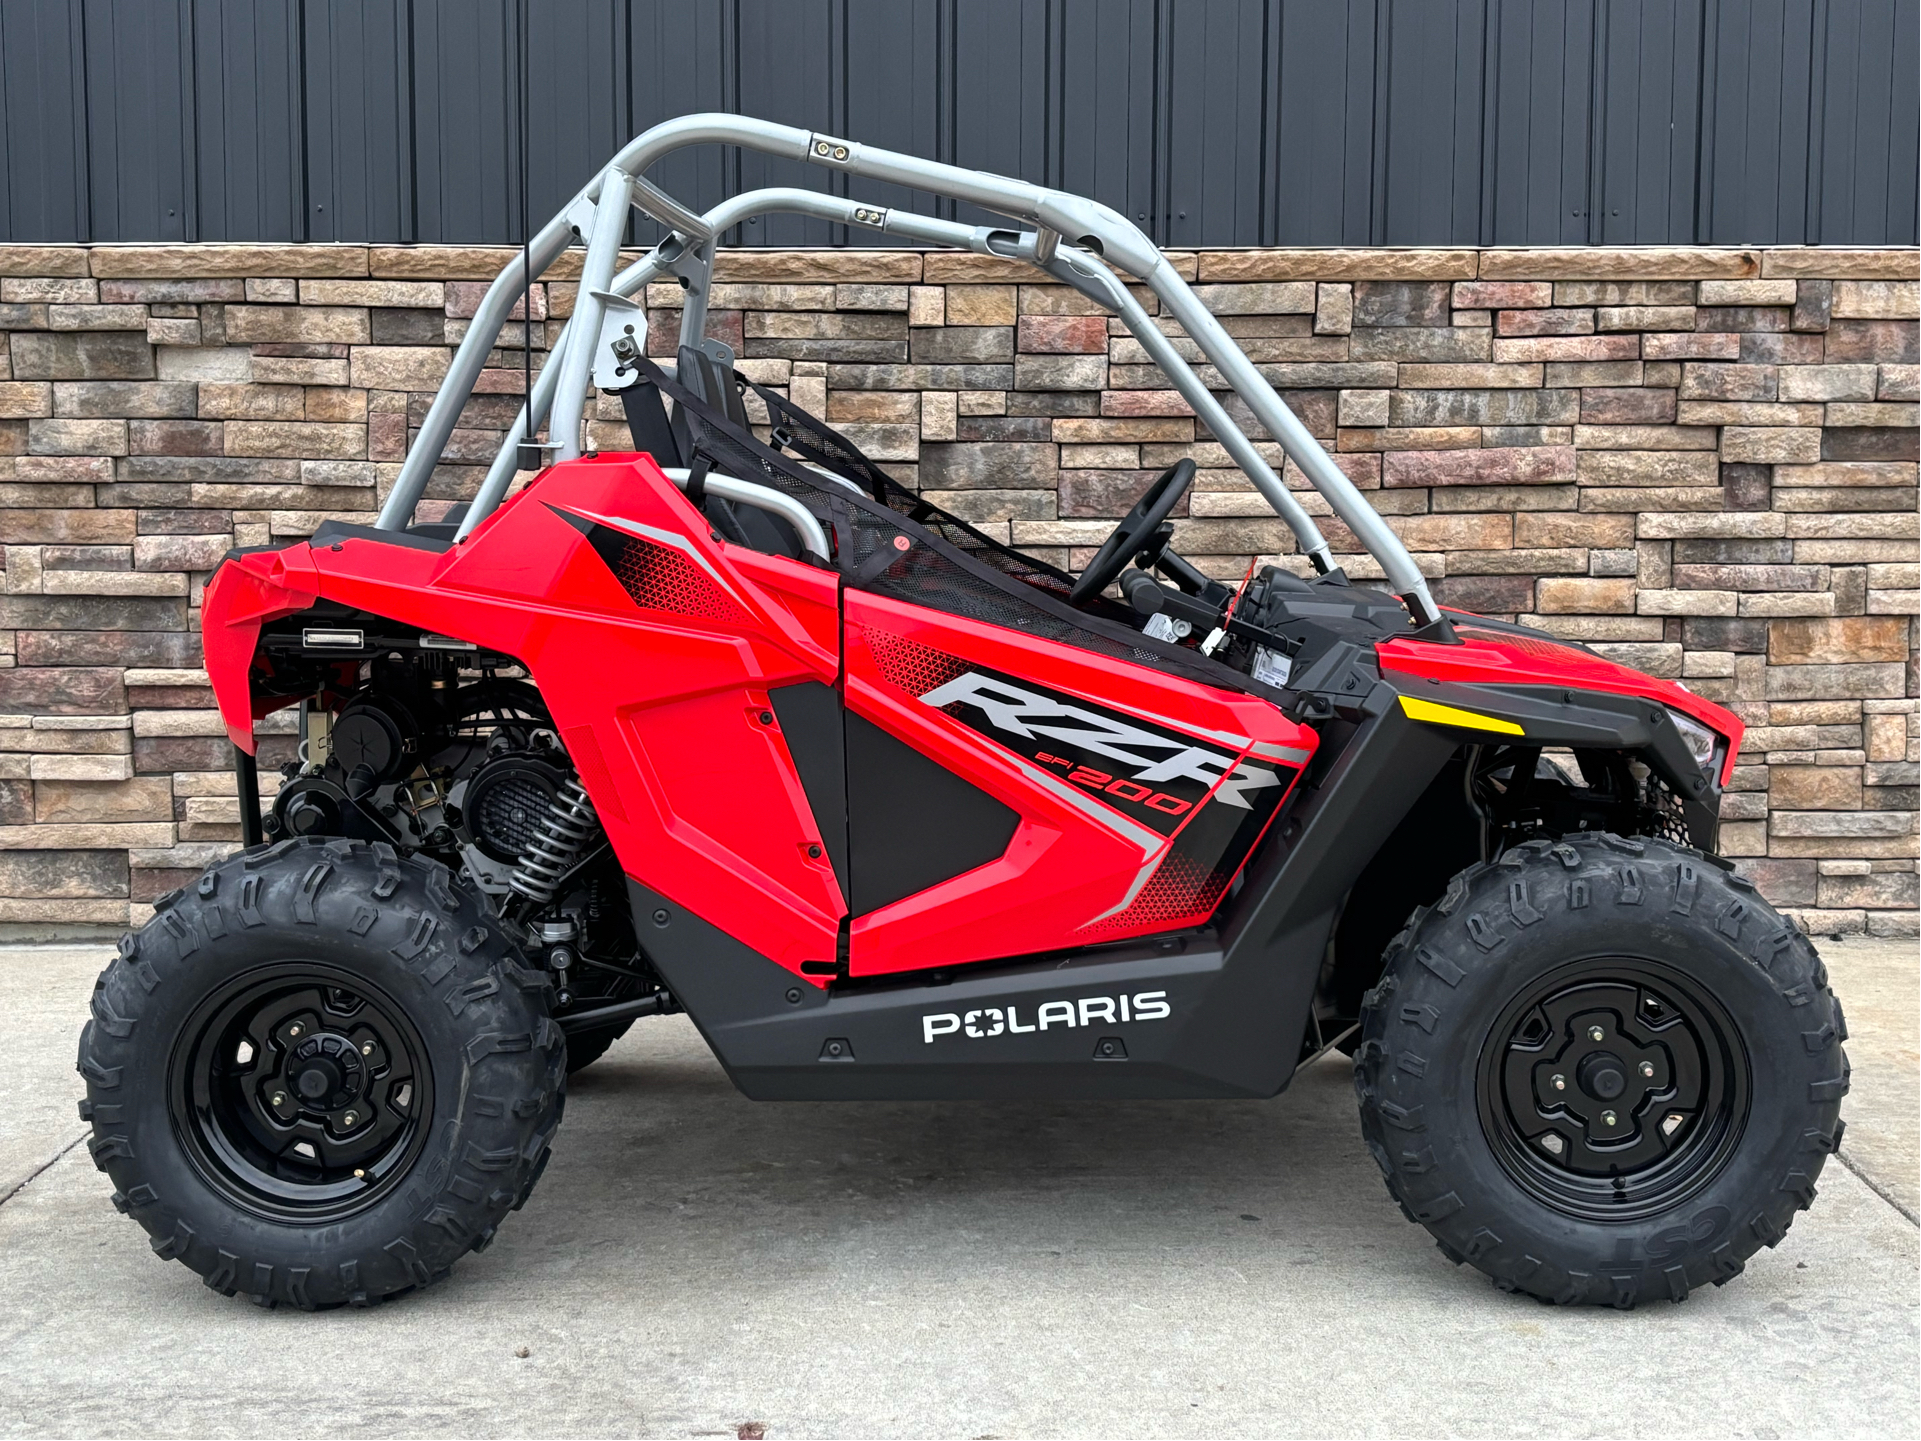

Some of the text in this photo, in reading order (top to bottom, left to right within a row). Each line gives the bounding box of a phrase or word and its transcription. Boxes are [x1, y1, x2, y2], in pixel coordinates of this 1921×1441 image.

[917, 671, 1282, 811] RZR
[1034, 751, 1193, 816] EFI 200
[922, 990, 1171, 1044] POLARIS
[1598, 1204, 1732, 1271] CST
